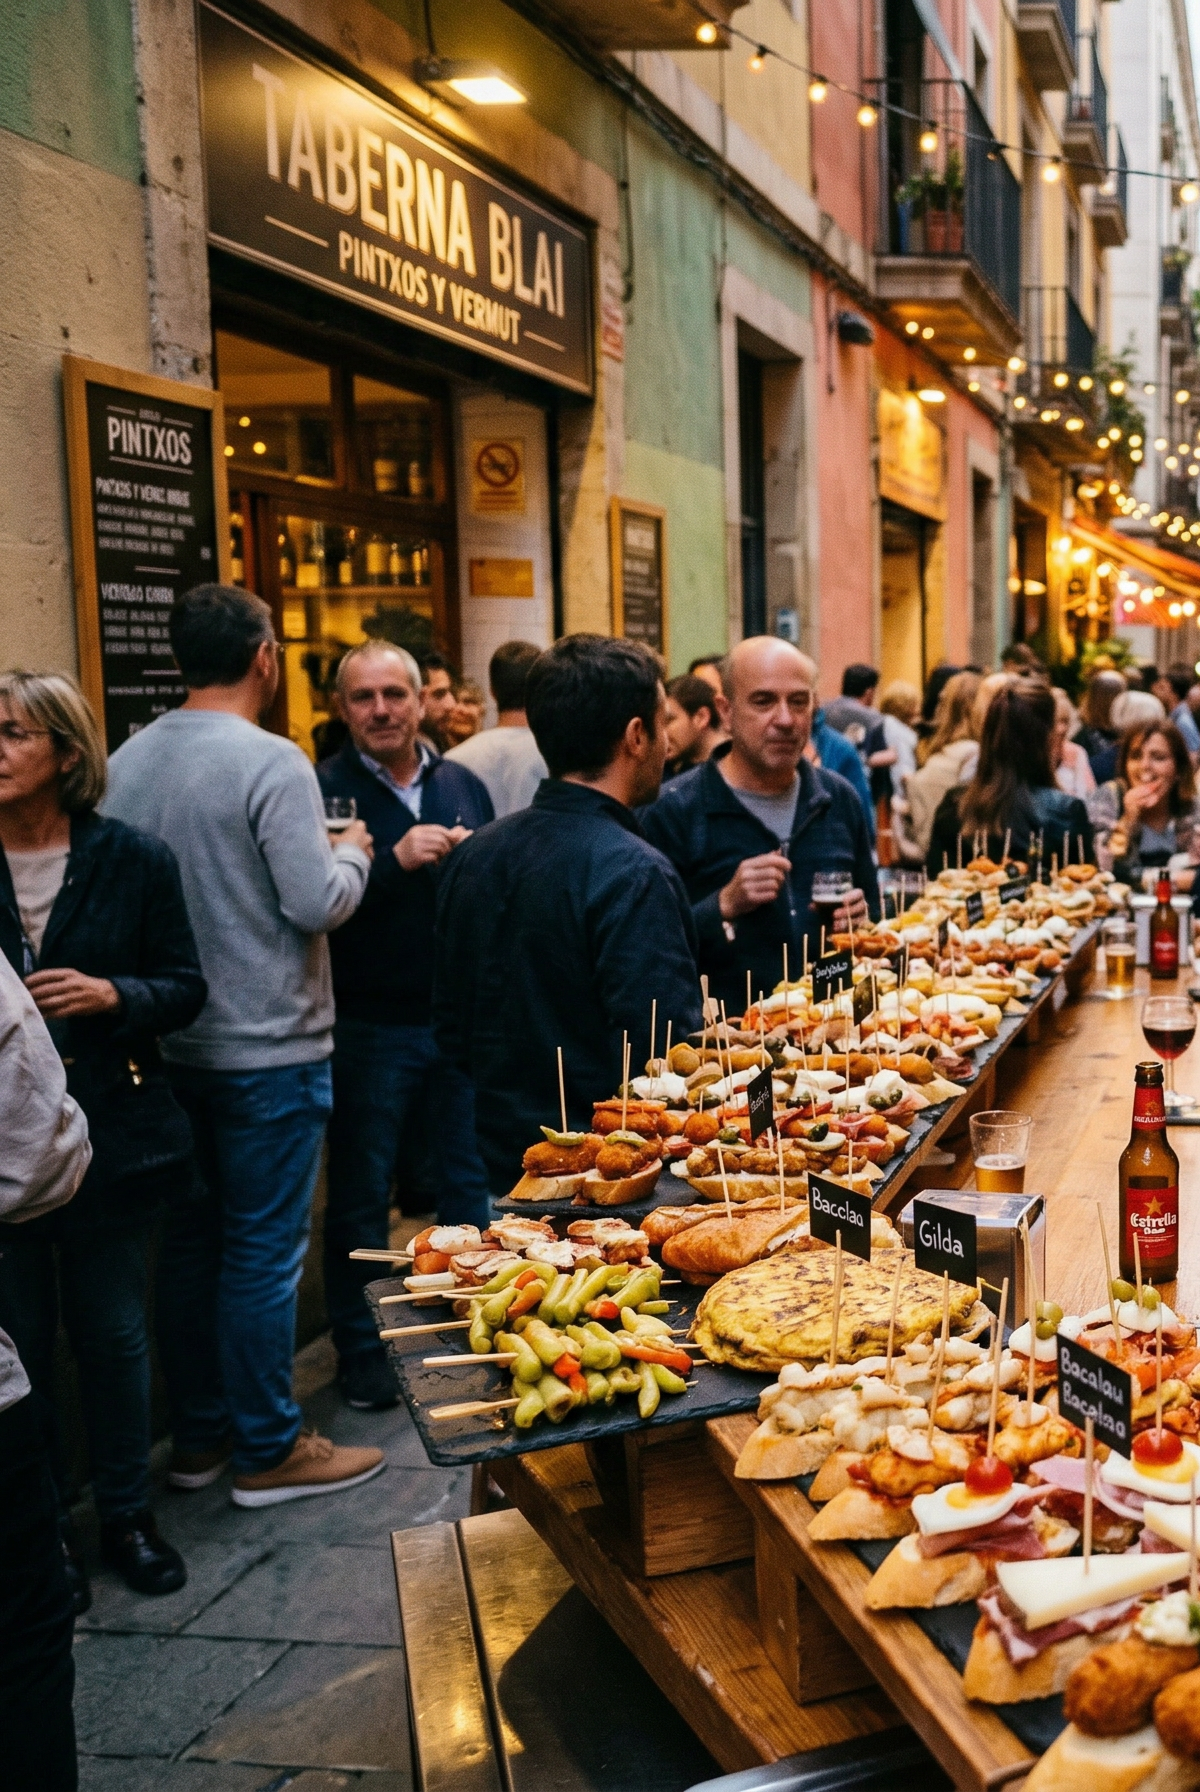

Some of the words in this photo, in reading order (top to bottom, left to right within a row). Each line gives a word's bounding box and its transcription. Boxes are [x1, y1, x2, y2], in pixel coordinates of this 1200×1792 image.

[252, 64, 476, 277] TABERNA
[488, 201, 565, 318] BLAI
[339, 231, 429, 307] PINTXOS
[430, 273, 451, 314] Y
[450, 285, 521, 344] VERMUT
[107, 415, 192, 466] PINTXOS
[919, 1220, 965, 1258] Gilda
[1130, 1212, 1177, 1228] Estrella
